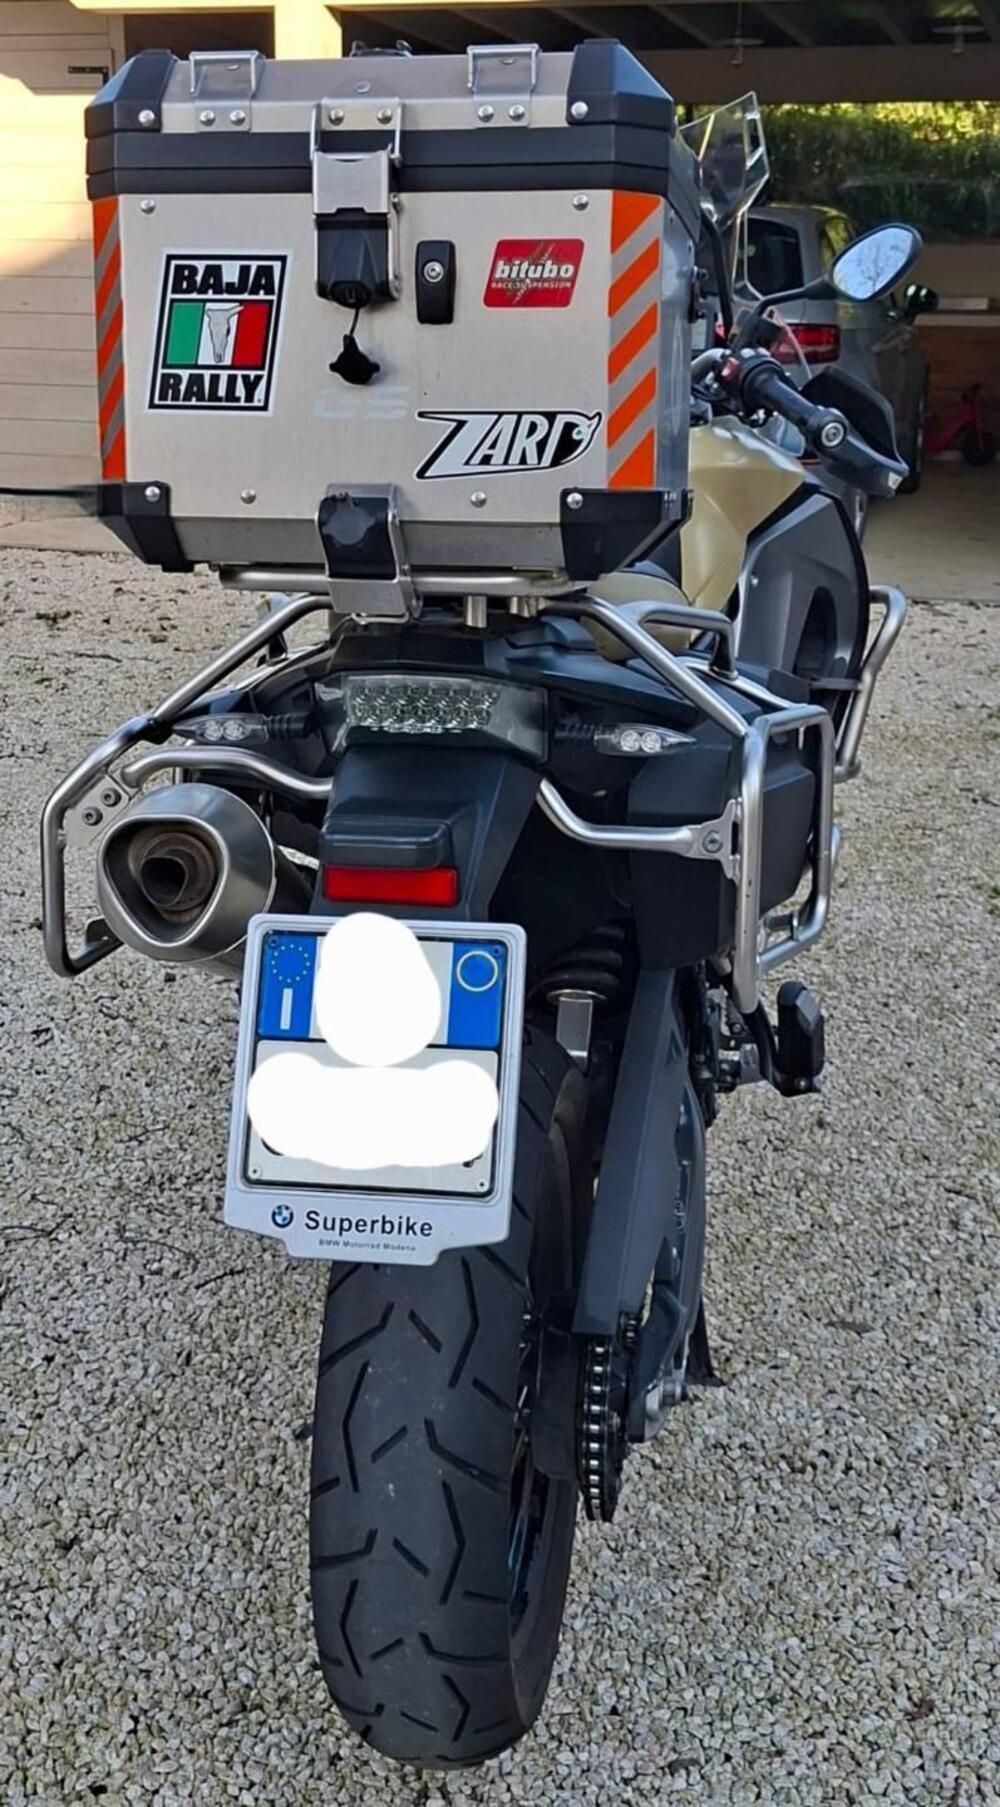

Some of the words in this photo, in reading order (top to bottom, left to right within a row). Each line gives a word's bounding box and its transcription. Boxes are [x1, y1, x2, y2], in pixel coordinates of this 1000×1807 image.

[171, 264, 276, 295] BAJA
[495, 260, 574, 279] bitubo
[157, 373, 265, 404] RALLY
[305, 1210, 433, 1237] Superbike
[318, 1238, 341, 1247] BMW
[343, 1240, 381, 1249] Motorrad
